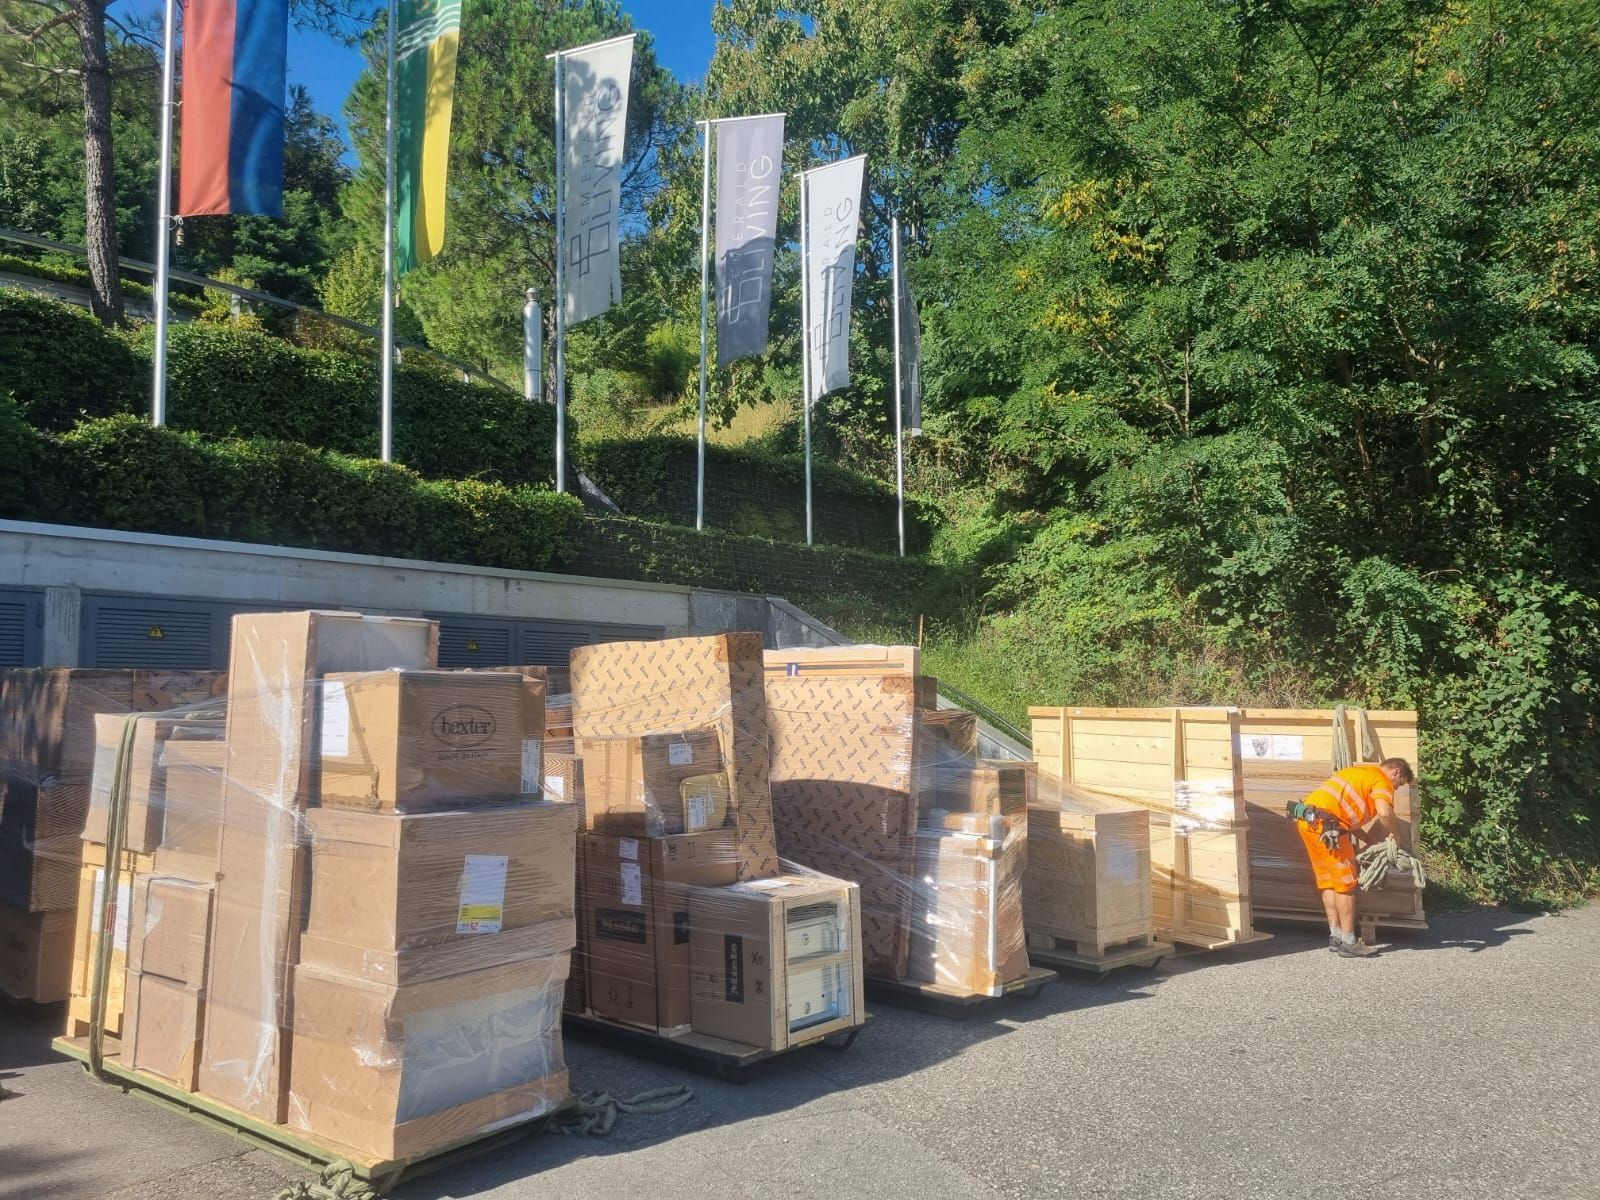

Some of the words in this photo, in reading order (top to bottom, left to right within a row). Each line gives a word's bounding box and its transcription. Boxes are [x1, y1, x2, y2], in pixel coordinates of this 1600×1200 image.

[580, 93, 595, 226] EMERALD
[591, 83, 621, 220] LIVING
[731, 162, 748, 279] EMERALD
[742, 155, 773, 275] LIVING
[831, 197, 853, 312] LIVING
[441, 715, 491, 735] baxter
[730, 943, 739, 995] Miele
